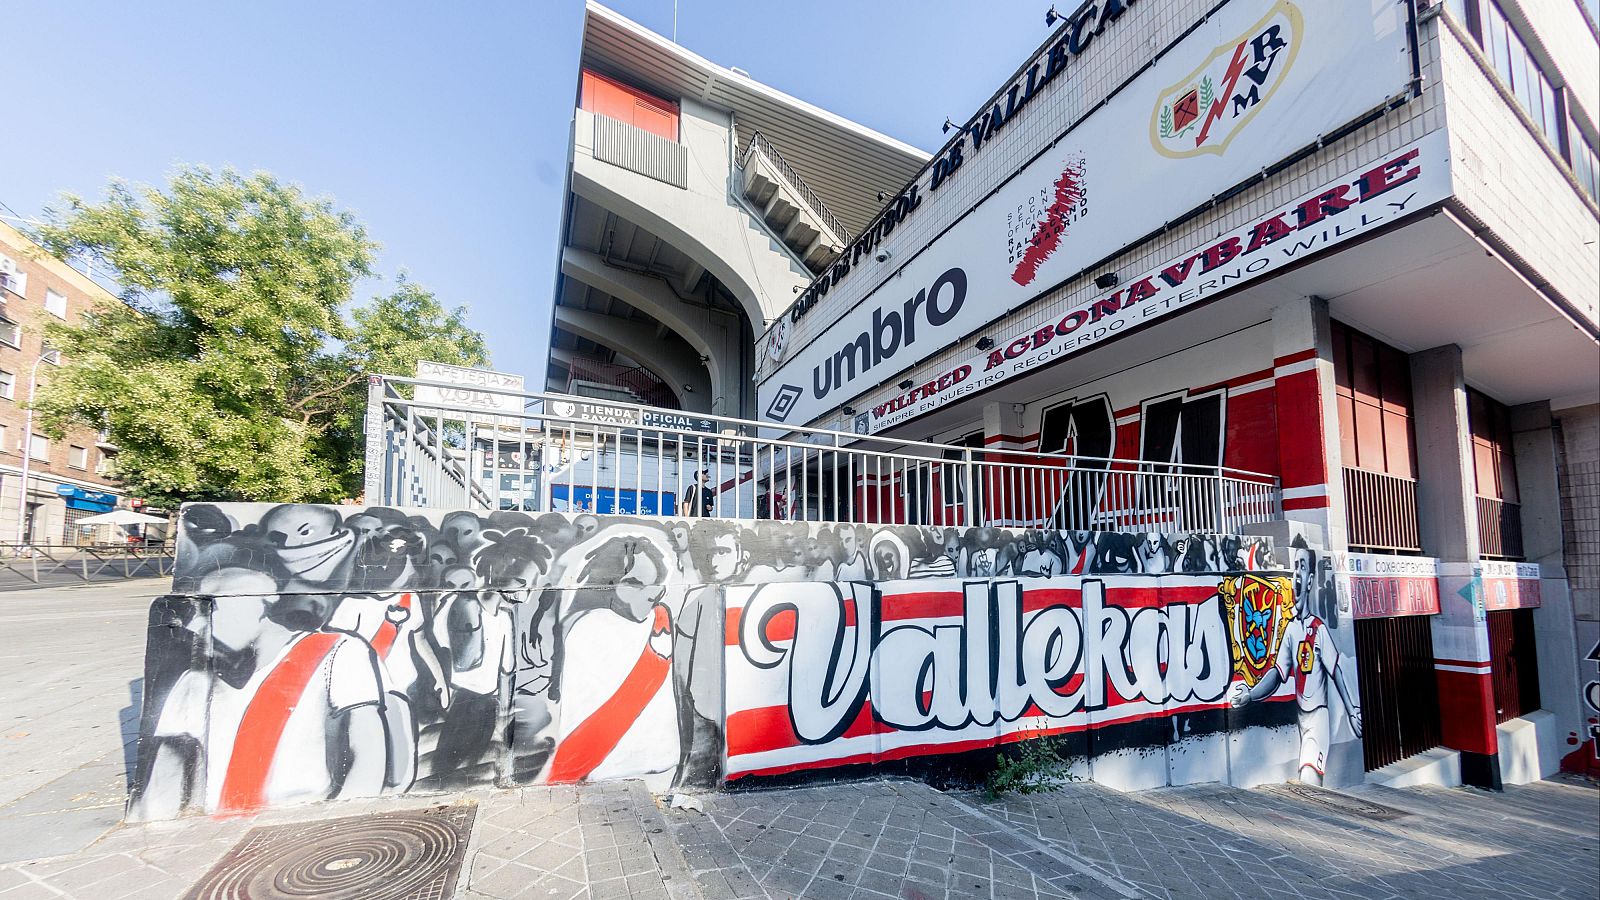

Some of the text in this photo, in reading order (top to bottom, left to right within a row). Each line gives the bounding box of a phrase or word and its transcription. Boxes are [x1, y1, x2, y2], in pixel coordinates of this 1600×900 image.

[791, 275, 830, 323] CAMPO
[831, 252, 850, 286] DE
[930, 138, 964, 191] DE
[970, 0, 1137, 150] VALLECA
[813, 267, 968, 400] umbro
[872, 147, 1421, 420] WILFRED AGBONAVBARE
[873, 191, 1418, 431] SIEMPRE EN NUESTRO RECUERDO ETERNO WILLY
[581, 404, 693, 426] TIENDA OFICIAL
[738, 578, 1233, 745] Vallekas
[1351, 580, 1386, 615] BOXEO
[1389, 580, 1407, 613] EL
[1408, 579, 1434, 612] RAYO
